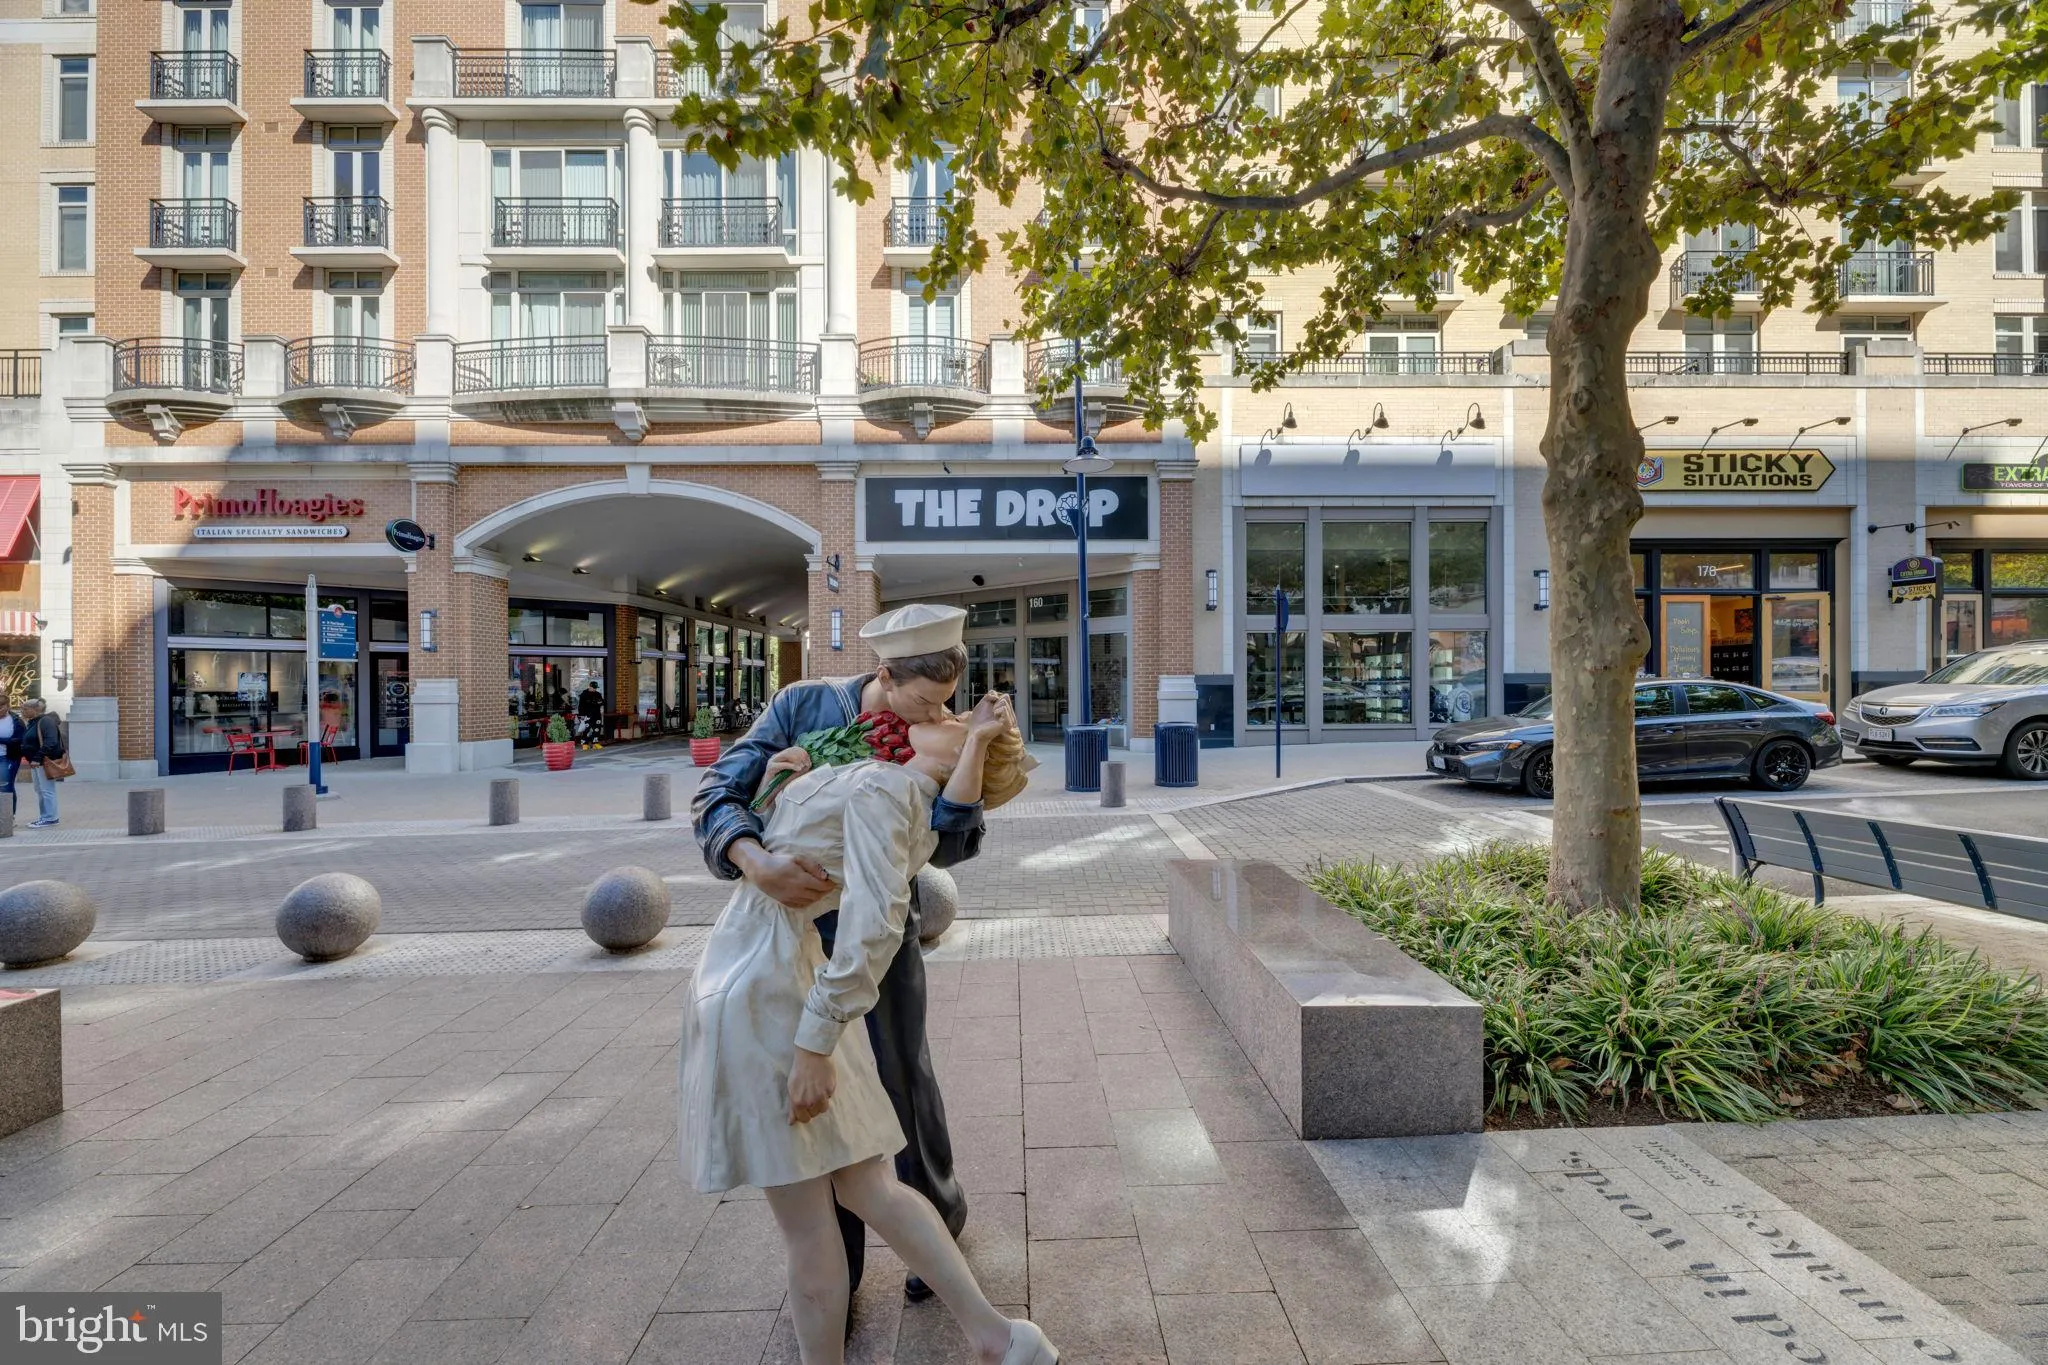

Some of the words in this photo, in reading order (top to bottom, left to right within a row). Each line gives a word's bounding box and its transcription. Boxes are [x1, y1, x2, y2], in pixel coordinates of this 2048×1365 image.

[1683, 453, 1814, 473] STICKY
[1683, 474, 1813, 486] SITUATIONS
[174, 486, 365, 522] PrimoHoagies
[894, 489, 982, 527] THE
[996, 489, 1120, 527] DROP
[197, 528, 232, 536] ITALIAN
[236, 528, 283, 536] SPECIALTY
[286, 528, 343, 536] SANDWICHES
[1029, 597, 1043, 608] 160
